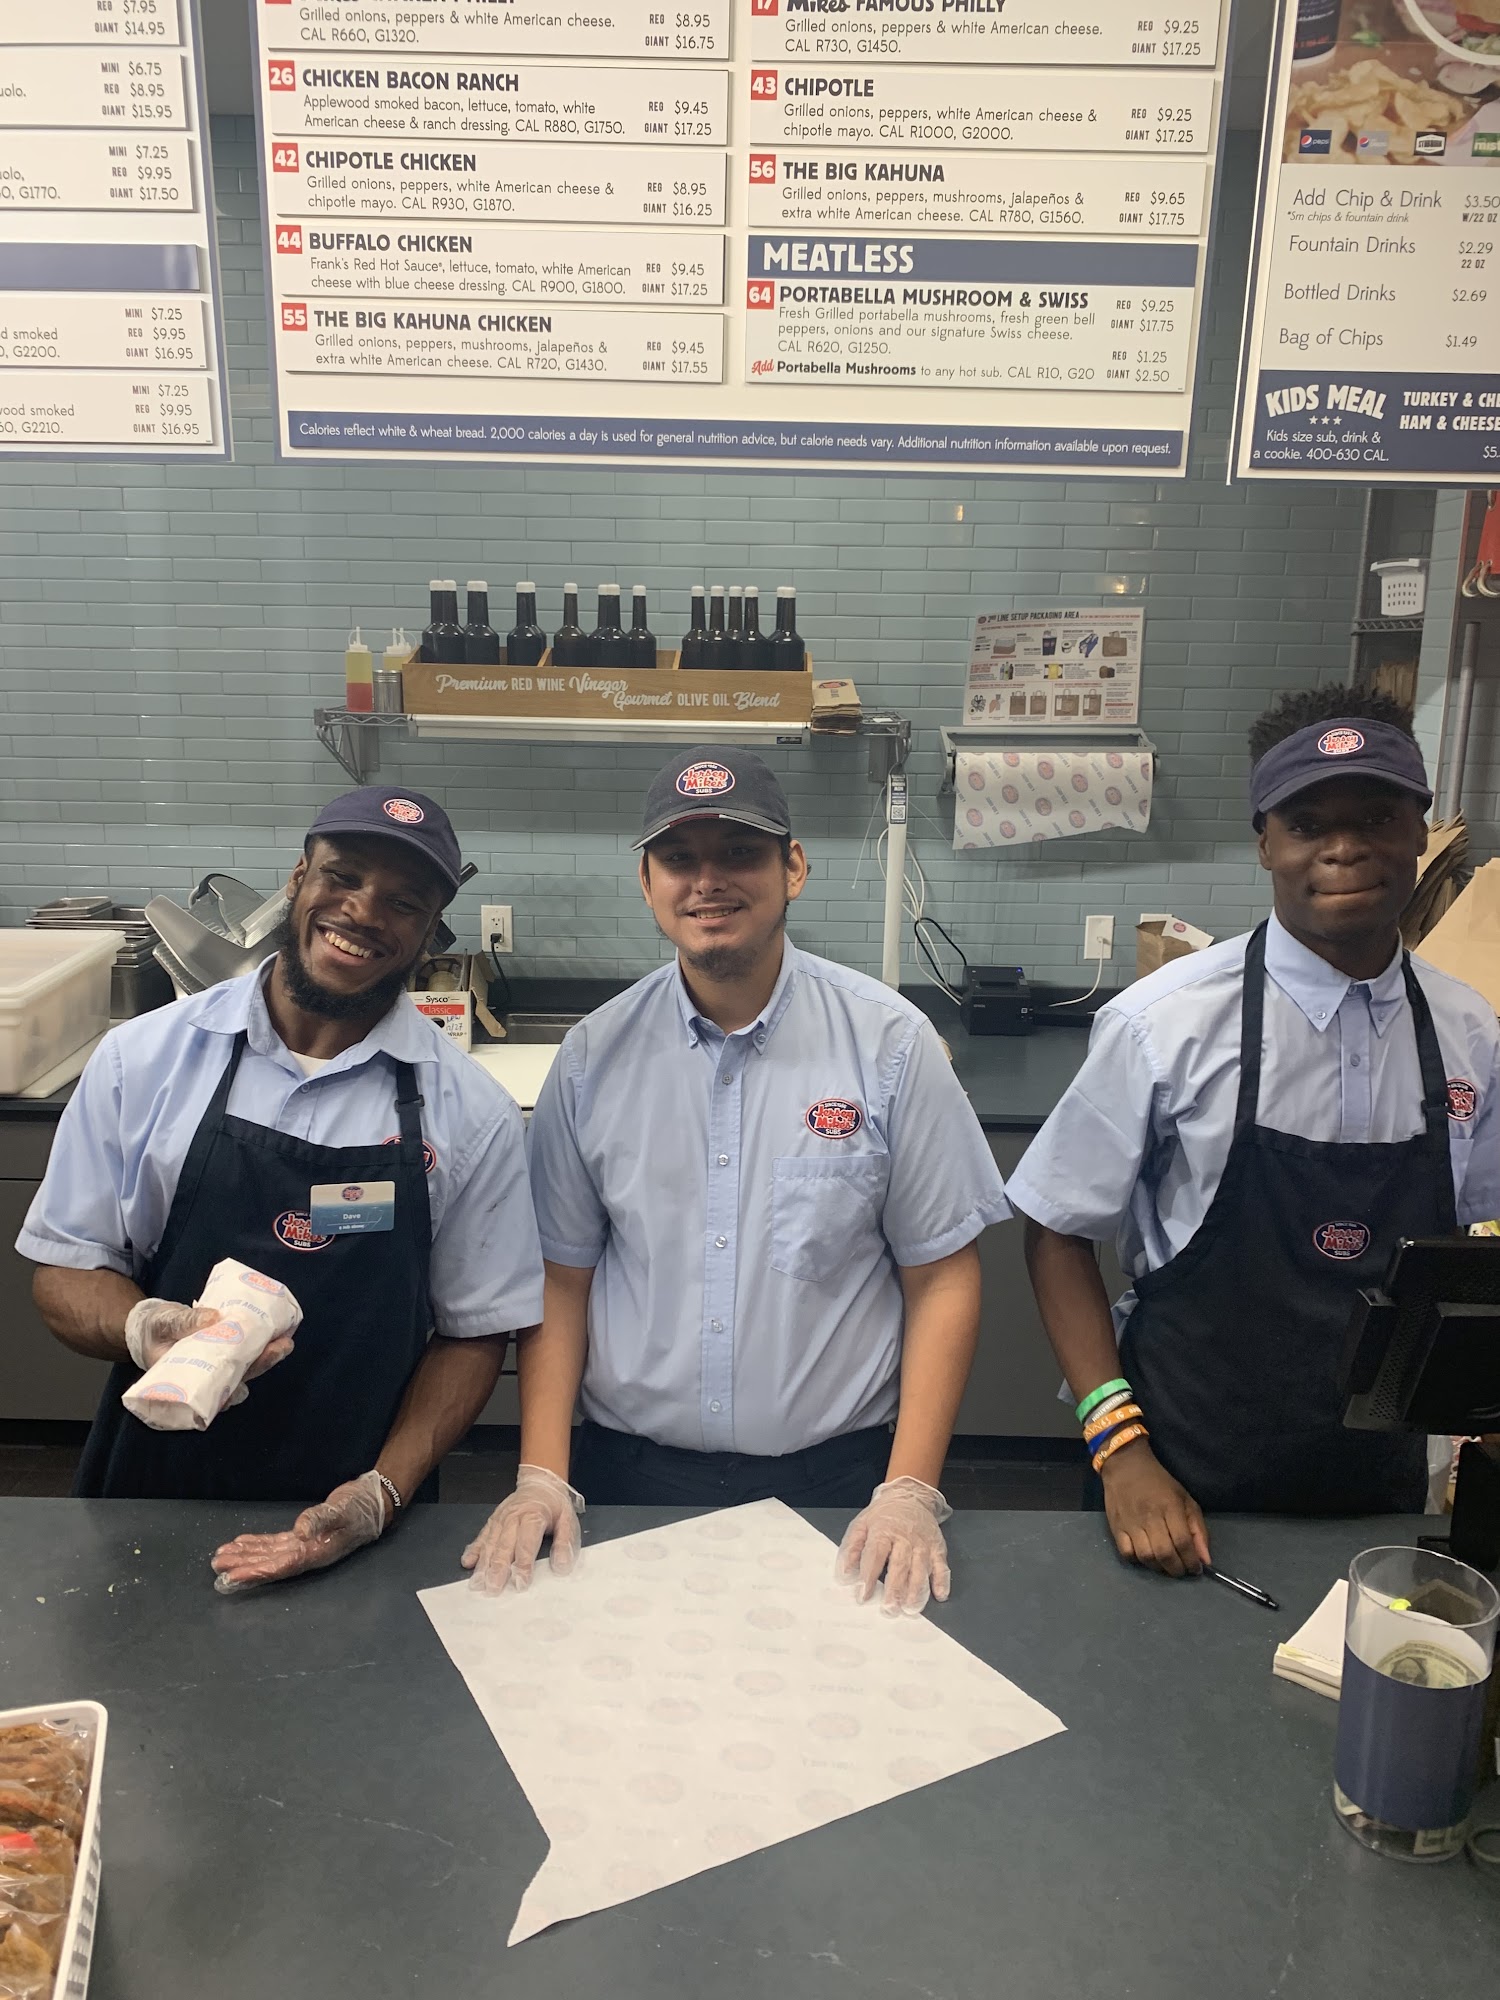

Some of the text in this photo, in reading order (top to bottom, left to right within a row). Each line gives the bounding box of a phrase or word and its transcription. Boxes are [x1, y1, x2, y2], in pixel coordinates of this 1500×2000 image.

[856, 0, 934, 12] FAMOUS
[941, 0, 1005, 12] PHILLY
[94, 20, 165, 36] GIANT $14.95
[270, 67, 518, 91] 26 CHICKEN BACON RANCH
[752, 76, 874, 97] 43 CHIPOTLE
[303, 93, 595, 114] Applewood smoked bacon, lettuce, tomato, white
[648, 99, 708, 115] REG $9.45
[644, 120, 711, 136] GIANT $17.25
[274, 149, 476, 171] 42 CHIPOTLE CHICKEN
[750, 160, 944, 182] 56 THE BIG KAHUNA
[1292, 187, 1500, 212] Add Chip & Drink $3.50
[278, 231, 472, 253] 44 BUFFALO CHICKEN
[1289, 234, 1493, 254] Fountain Drinks $2.29
[763, 242, 913, 273] MEATLESS
[1460, 258, 1485, 269] 22 OZ
[310, 256, 349, 270] Frank's
[353, 257, 375, 270] Red
[380, 258, 399, 271] Hot
[449, 259, 491, 274] lettuce,
[495, 261, 537, 275] tomato,
[541, 261, 573, 274] white
[577, 262, 631, 276] American
[748, 285, 1088, 309] 64 PORTABELLA MUSHROOM & SWISS
[1284, 282, 1487, 302] Bottled Drinks $2.69
[1116, 298, 1174, 312] REG $9.25
[283, 308, 551, 333] 55 THE BIG KAHUNA CHICKEN
[779, 306, 1095, 327] Fresh Grilled portabella mushrooms, fresh green bell
[1110, 318, 1174, 332] GIANT $17.75
[1279, 327, 1477, 350] Bag of Chips $1.49
[132, 383, 189, 397] MINI $7.25
[1265, 384, 1387, 419] KIDS MEAL
[1403, 391, 1458, 406] TURKEY
[1462, 392, 1473, 407] &
[30, 403, 74, 416] smoked
[134, 402, 192, 416] REG $9.95
[21, 421, 63, 433] G2210.
[133, 422, 199, 435] GIANT $16.95
[1399, 414, 1500, 431] HAM & CHEESE
[299, 422, 598, 443] Calories reflect white & wheat bread. 2,000 calories a day
[1266, 429, 1381, 444] Kids size sub, drink &
[1252, 448, 1389, 461] a cookie. 400-630 CAL.
[1011, 612, 1029, 621] SETUP
[1030, 611, 1062, 620] PACKAGING
[1064, 610, 1080, 619] AREA
[435, 672, 628, 697] Premium RED WINE Vinegar
[611, 689, 780, 711] Gourmet OLIVE OIL Blend
[683, 768, 728, 780] Jersey
[425, 995, 449, 1004] Sysco
[422, 1005, 452, 1015] Classic
[282, 1213, 311, 1229] Jers
[293, 1240, 312, 1248] SUBS
